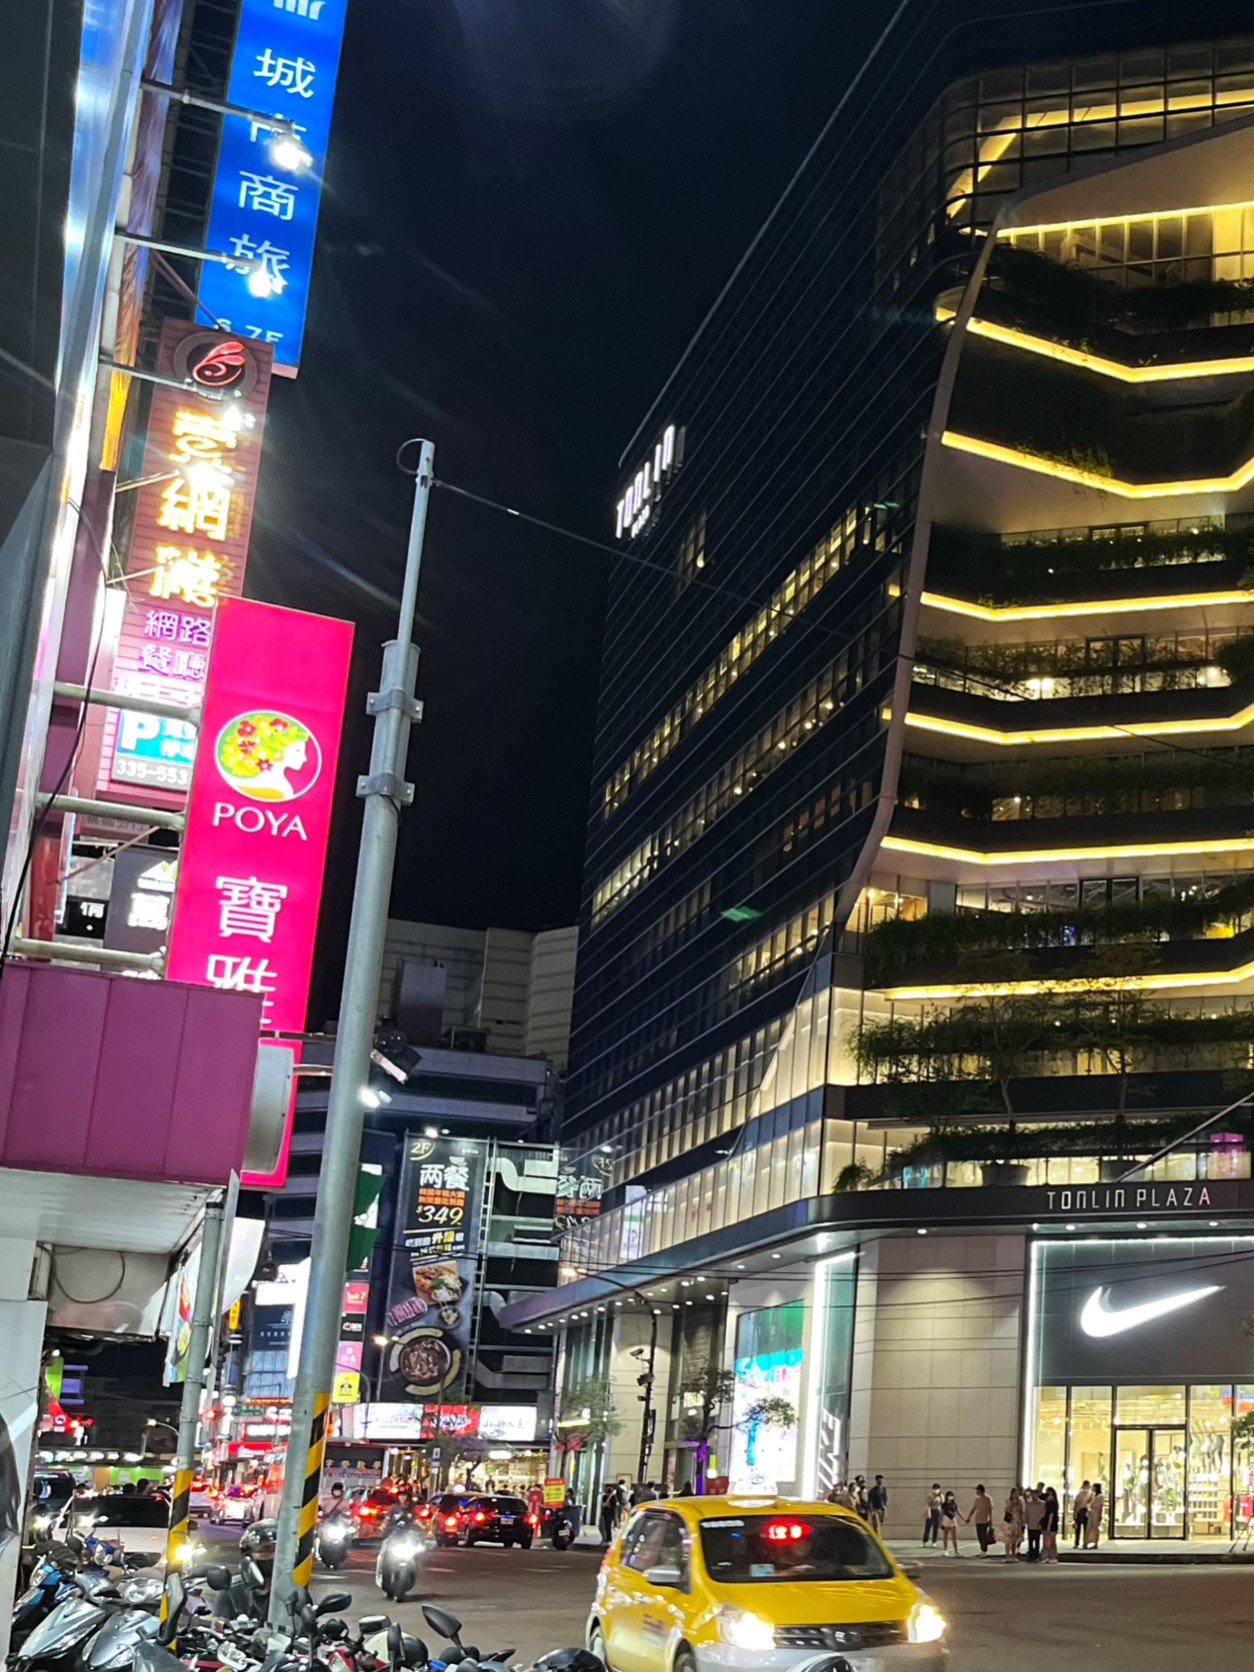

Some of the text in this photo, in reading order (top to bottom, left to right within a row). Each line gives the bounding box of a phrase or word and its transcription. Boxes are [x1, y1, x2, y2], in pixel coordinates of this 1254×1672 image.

[144, 609, 212, 647] 網路
[213, 801, 308, 841] POYA
[410, 1141, 432, 1154] 2F
[1047, 1186, 1211, 1210] TONLIN PLAZA
[415, 1204, 464, 1226] $349
